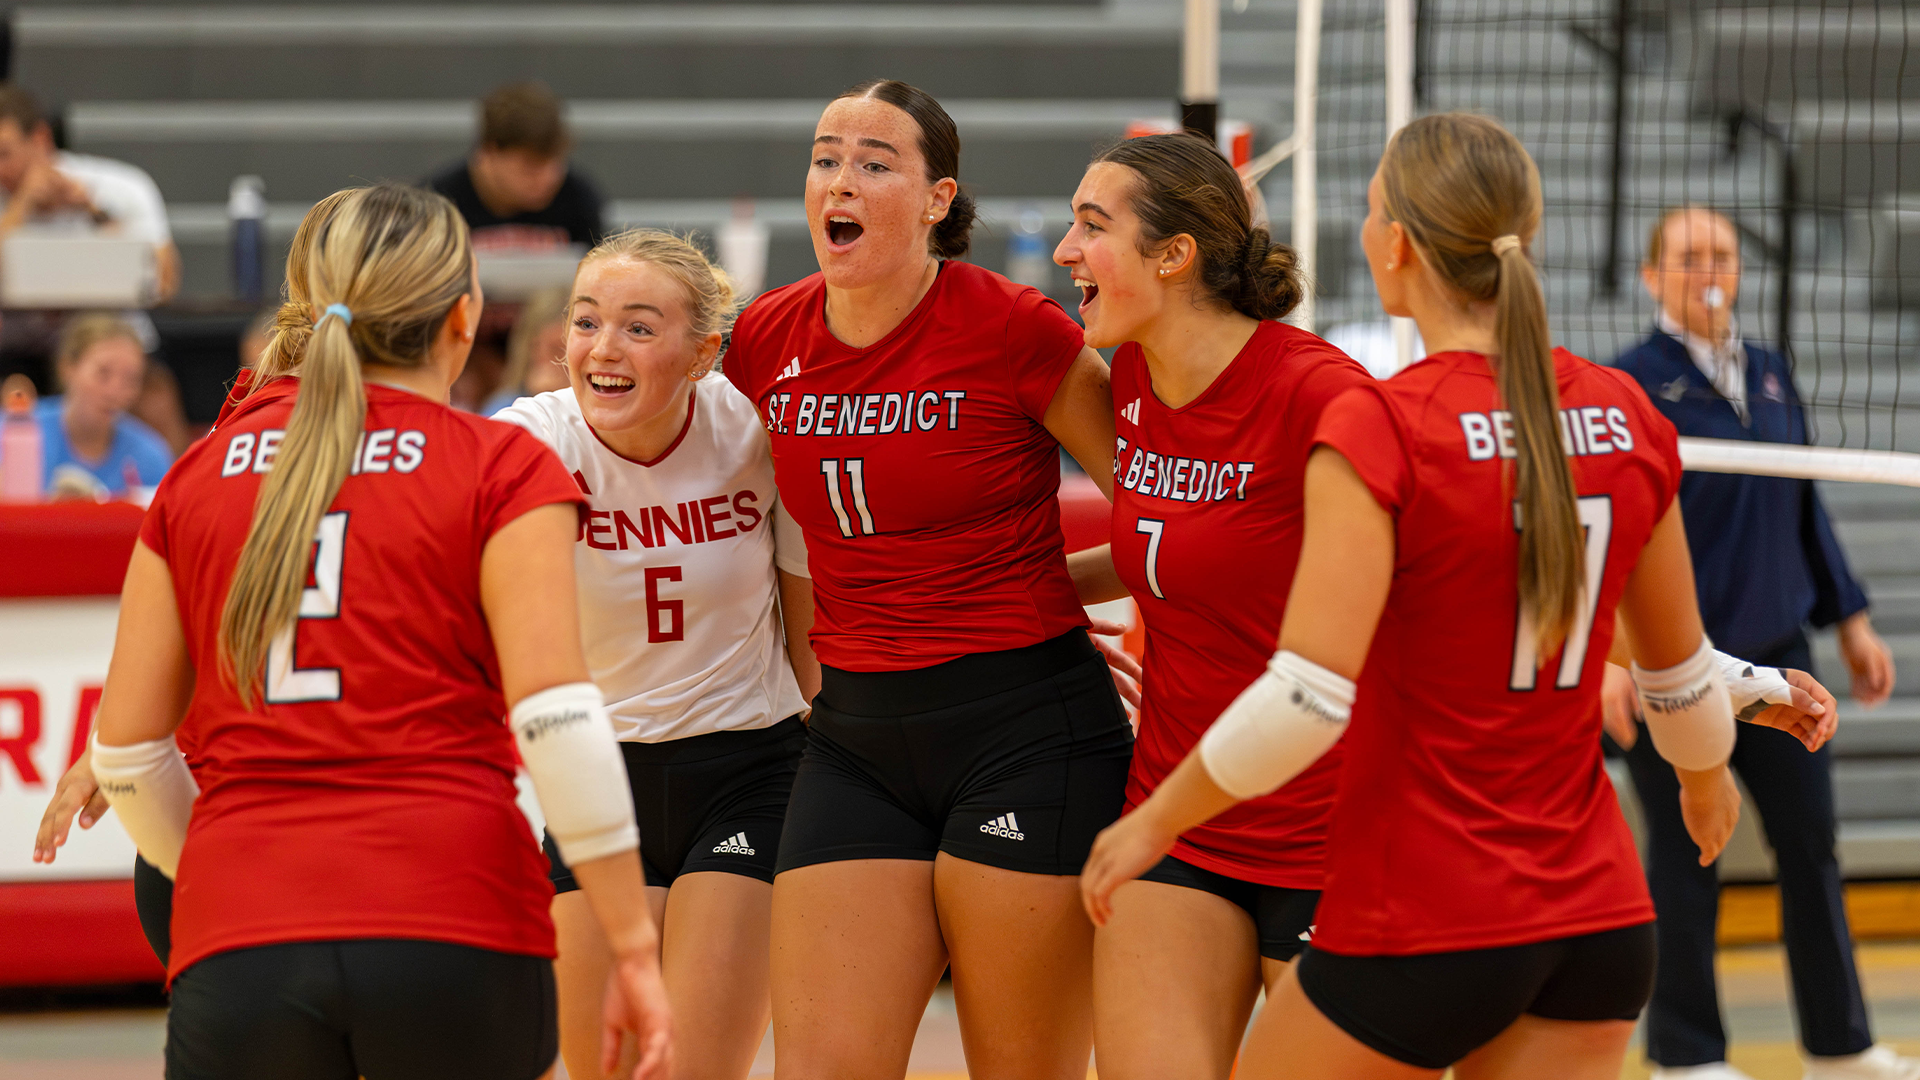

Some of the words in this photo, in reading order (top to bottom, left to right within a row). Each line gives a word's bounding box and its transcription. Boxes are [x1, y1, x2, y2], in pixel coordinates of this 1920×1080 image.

[794, 389, 967, 437] BENEDICT
[819, 456, 877, 540] 11
[1122, 446, 1256, 504] BENEDICT
[577, 489, 762, 551] ENNIES
[1135, 516, 1168, 602] 7
[264, 510, 351, 705] 2
[643, 565, 684, 644] 6
[979, 823, 1025, 841] adidas
